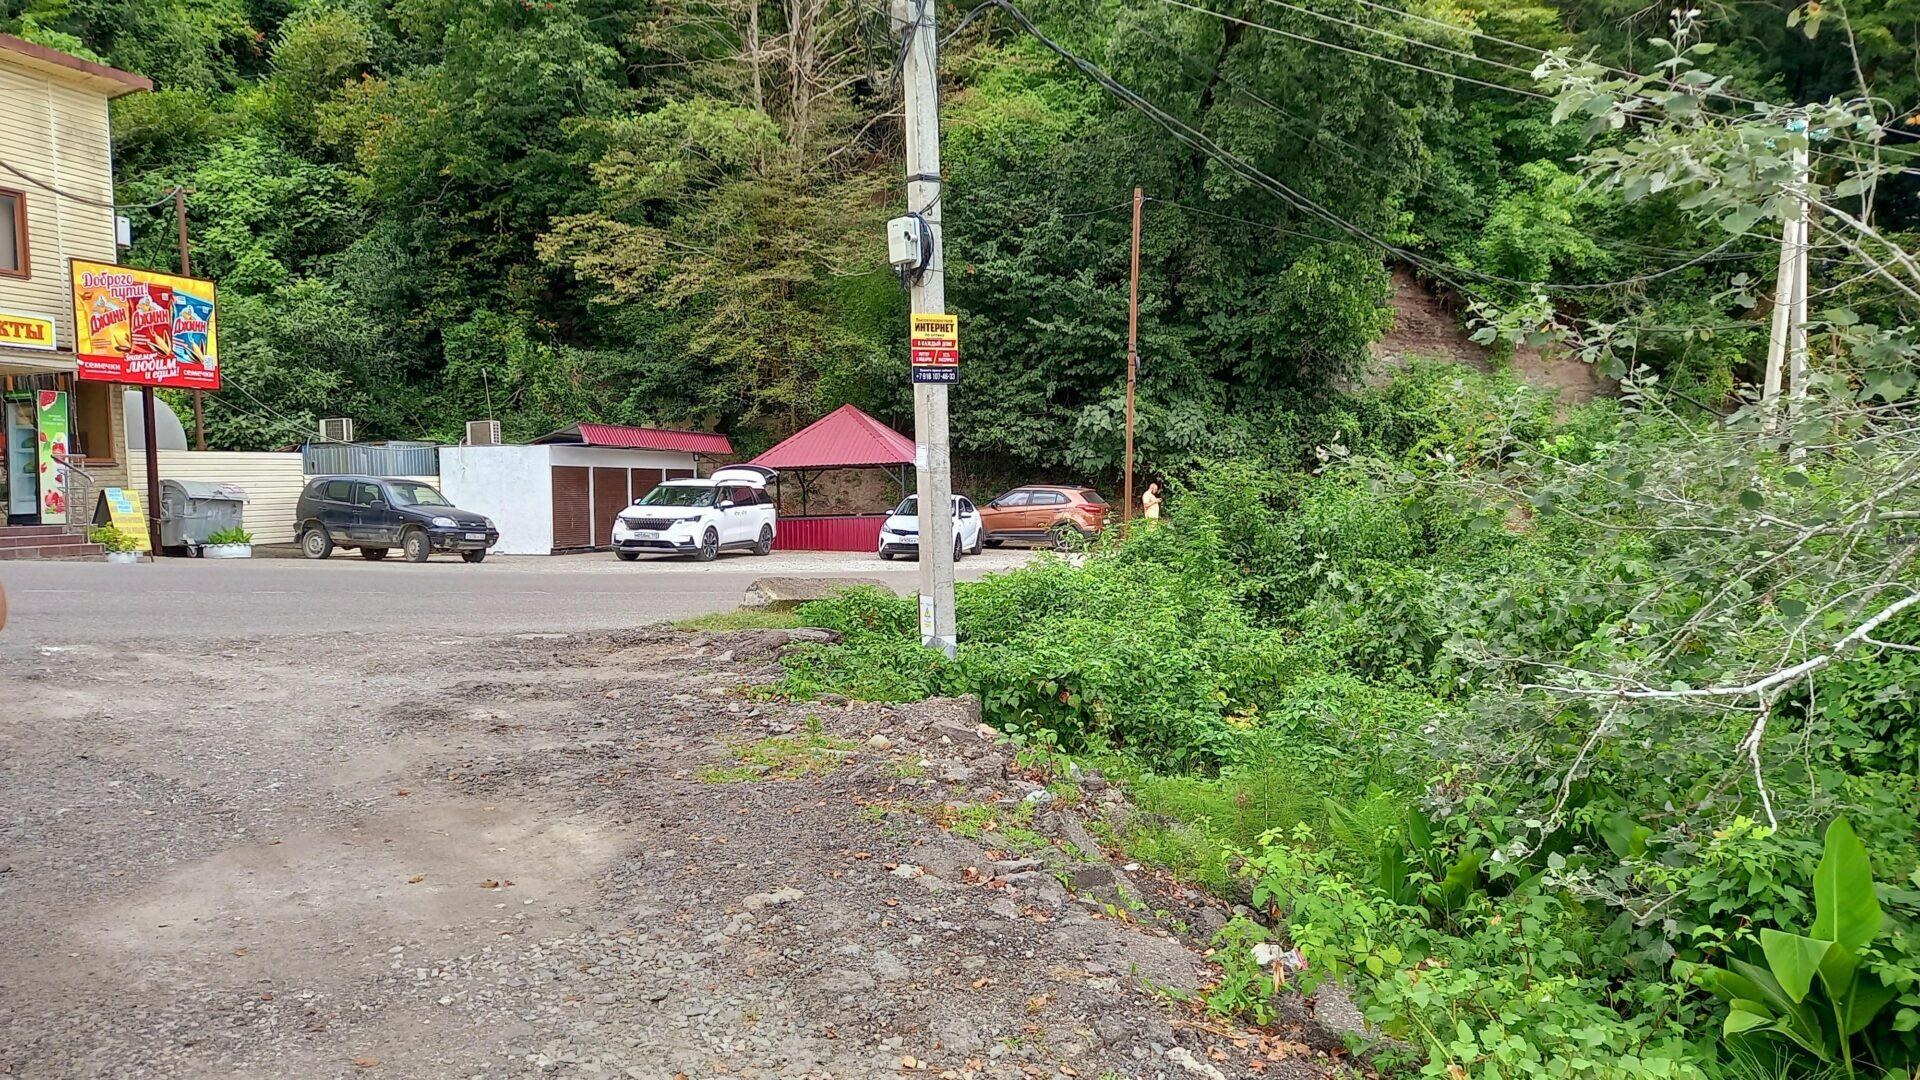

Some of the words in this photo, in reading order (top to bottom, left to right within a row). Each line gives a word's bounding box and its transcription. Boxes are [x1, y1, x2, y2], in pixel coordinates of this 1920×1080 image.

[82, 272, 132, 289] Доброго
[111, 282, 149, 301] пути!
[915, 323, 954, 332] ИНТЕРНЕТ
[85, 361, 120, 371] семечки
[183, 369, 214, 378] семечки
